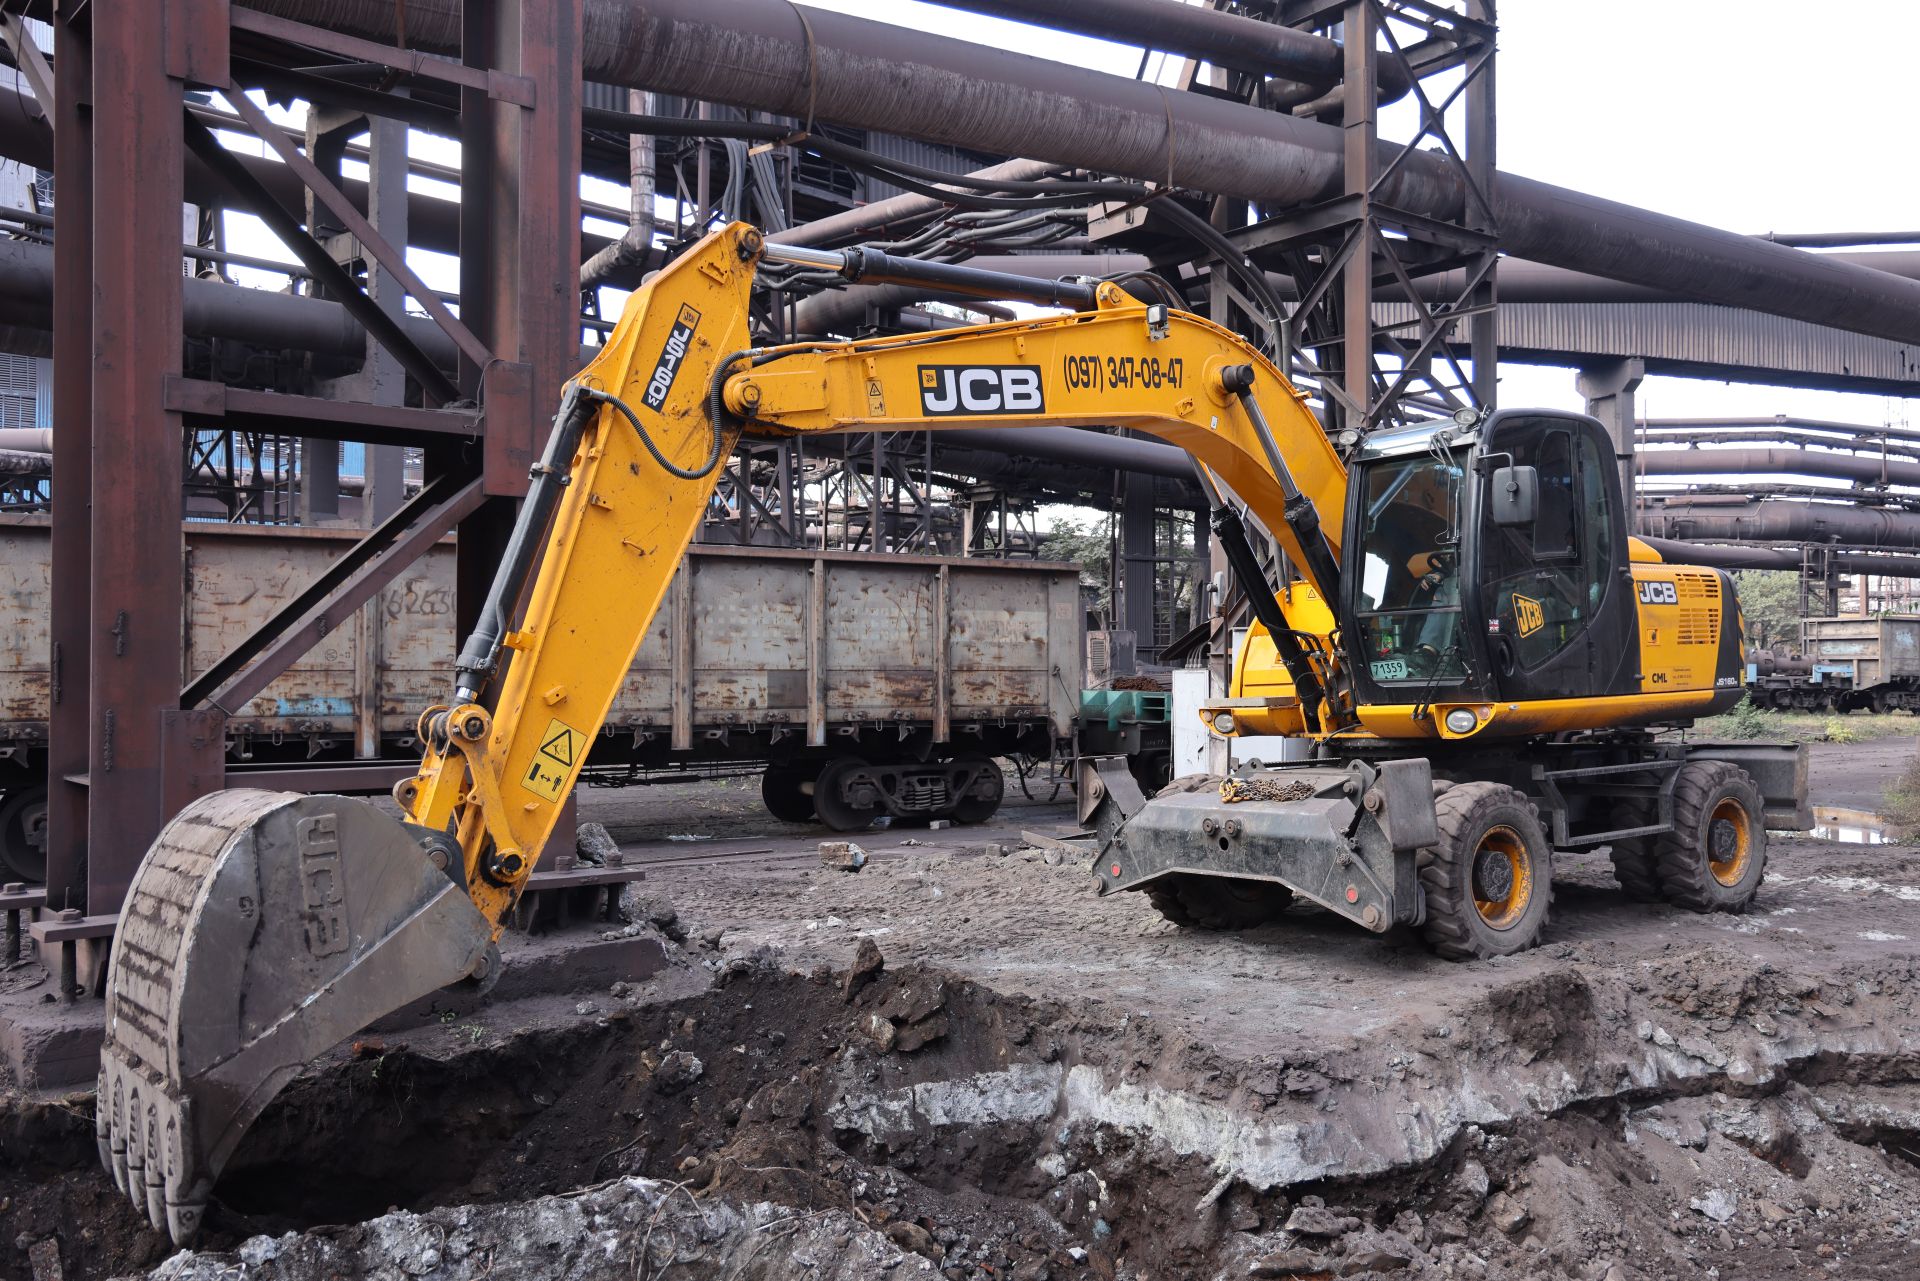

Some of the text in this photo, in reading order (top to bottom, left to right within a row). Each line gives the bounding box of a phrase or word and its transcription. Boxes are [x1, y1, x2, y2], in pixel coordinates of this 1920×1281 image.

[924, 368, 1042, 411] JCB
[1064, 354, 1184, 394] (097) 347-08-47
[1639, 582, 1677, 603] JCB
[1517, 598, 1543, 633] JCB
[1372, 661, 1403, 676] 71359
